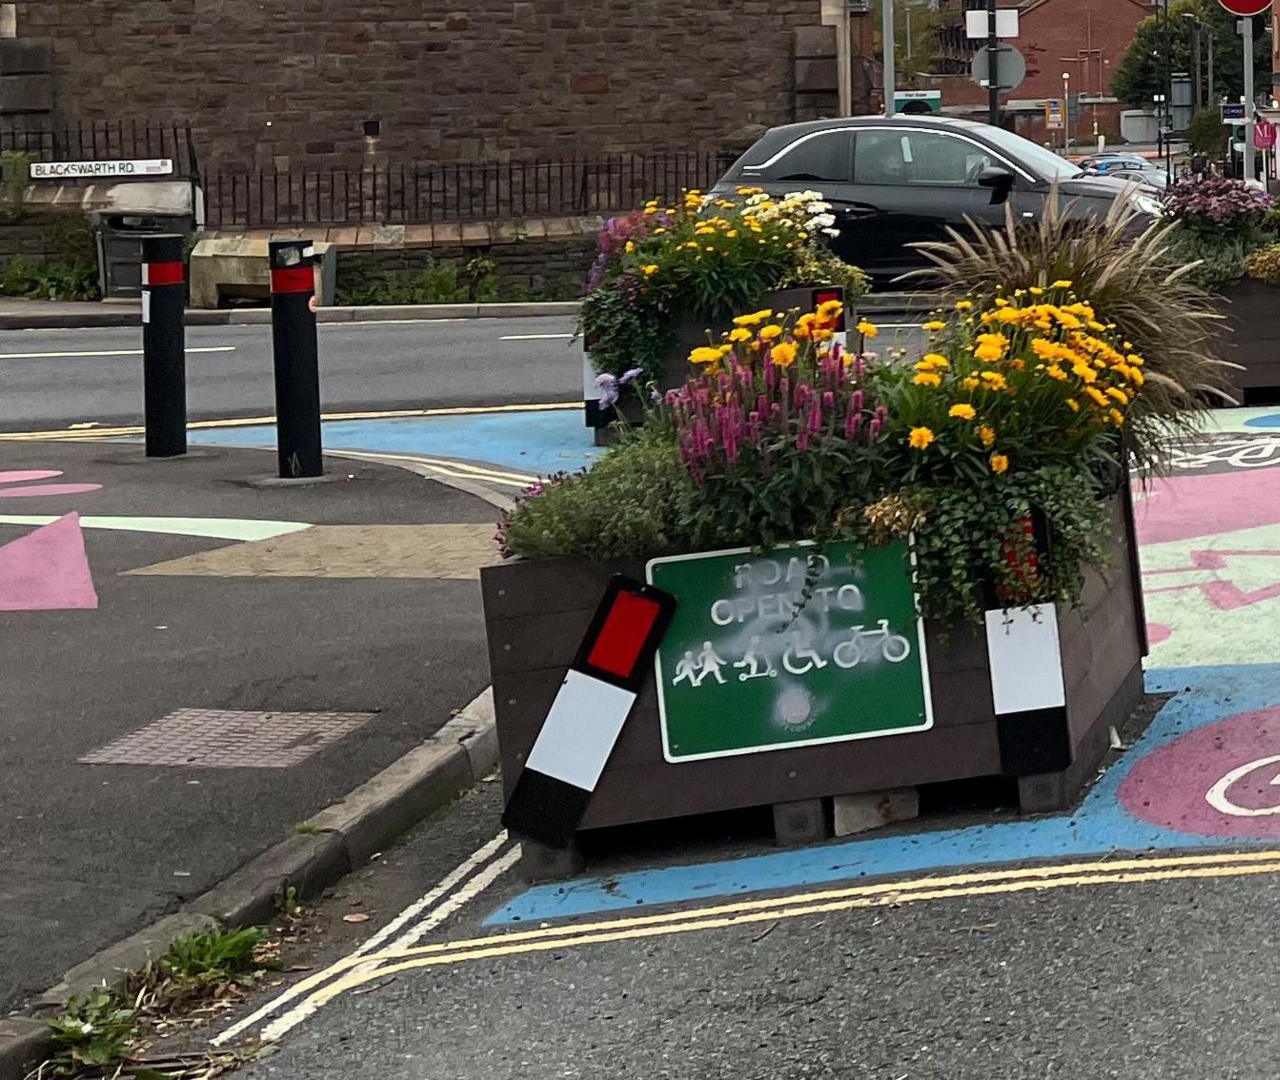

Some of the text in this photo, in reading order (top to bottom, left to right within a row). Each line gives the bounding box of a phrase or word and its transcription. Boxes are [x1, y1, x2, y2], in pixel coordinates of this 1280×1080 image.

[35, 162, 116, 176] BLACKSWARTH
[733, 554, 831, 589] ROAD
[711, 583, 865, 626] OPEN TO
